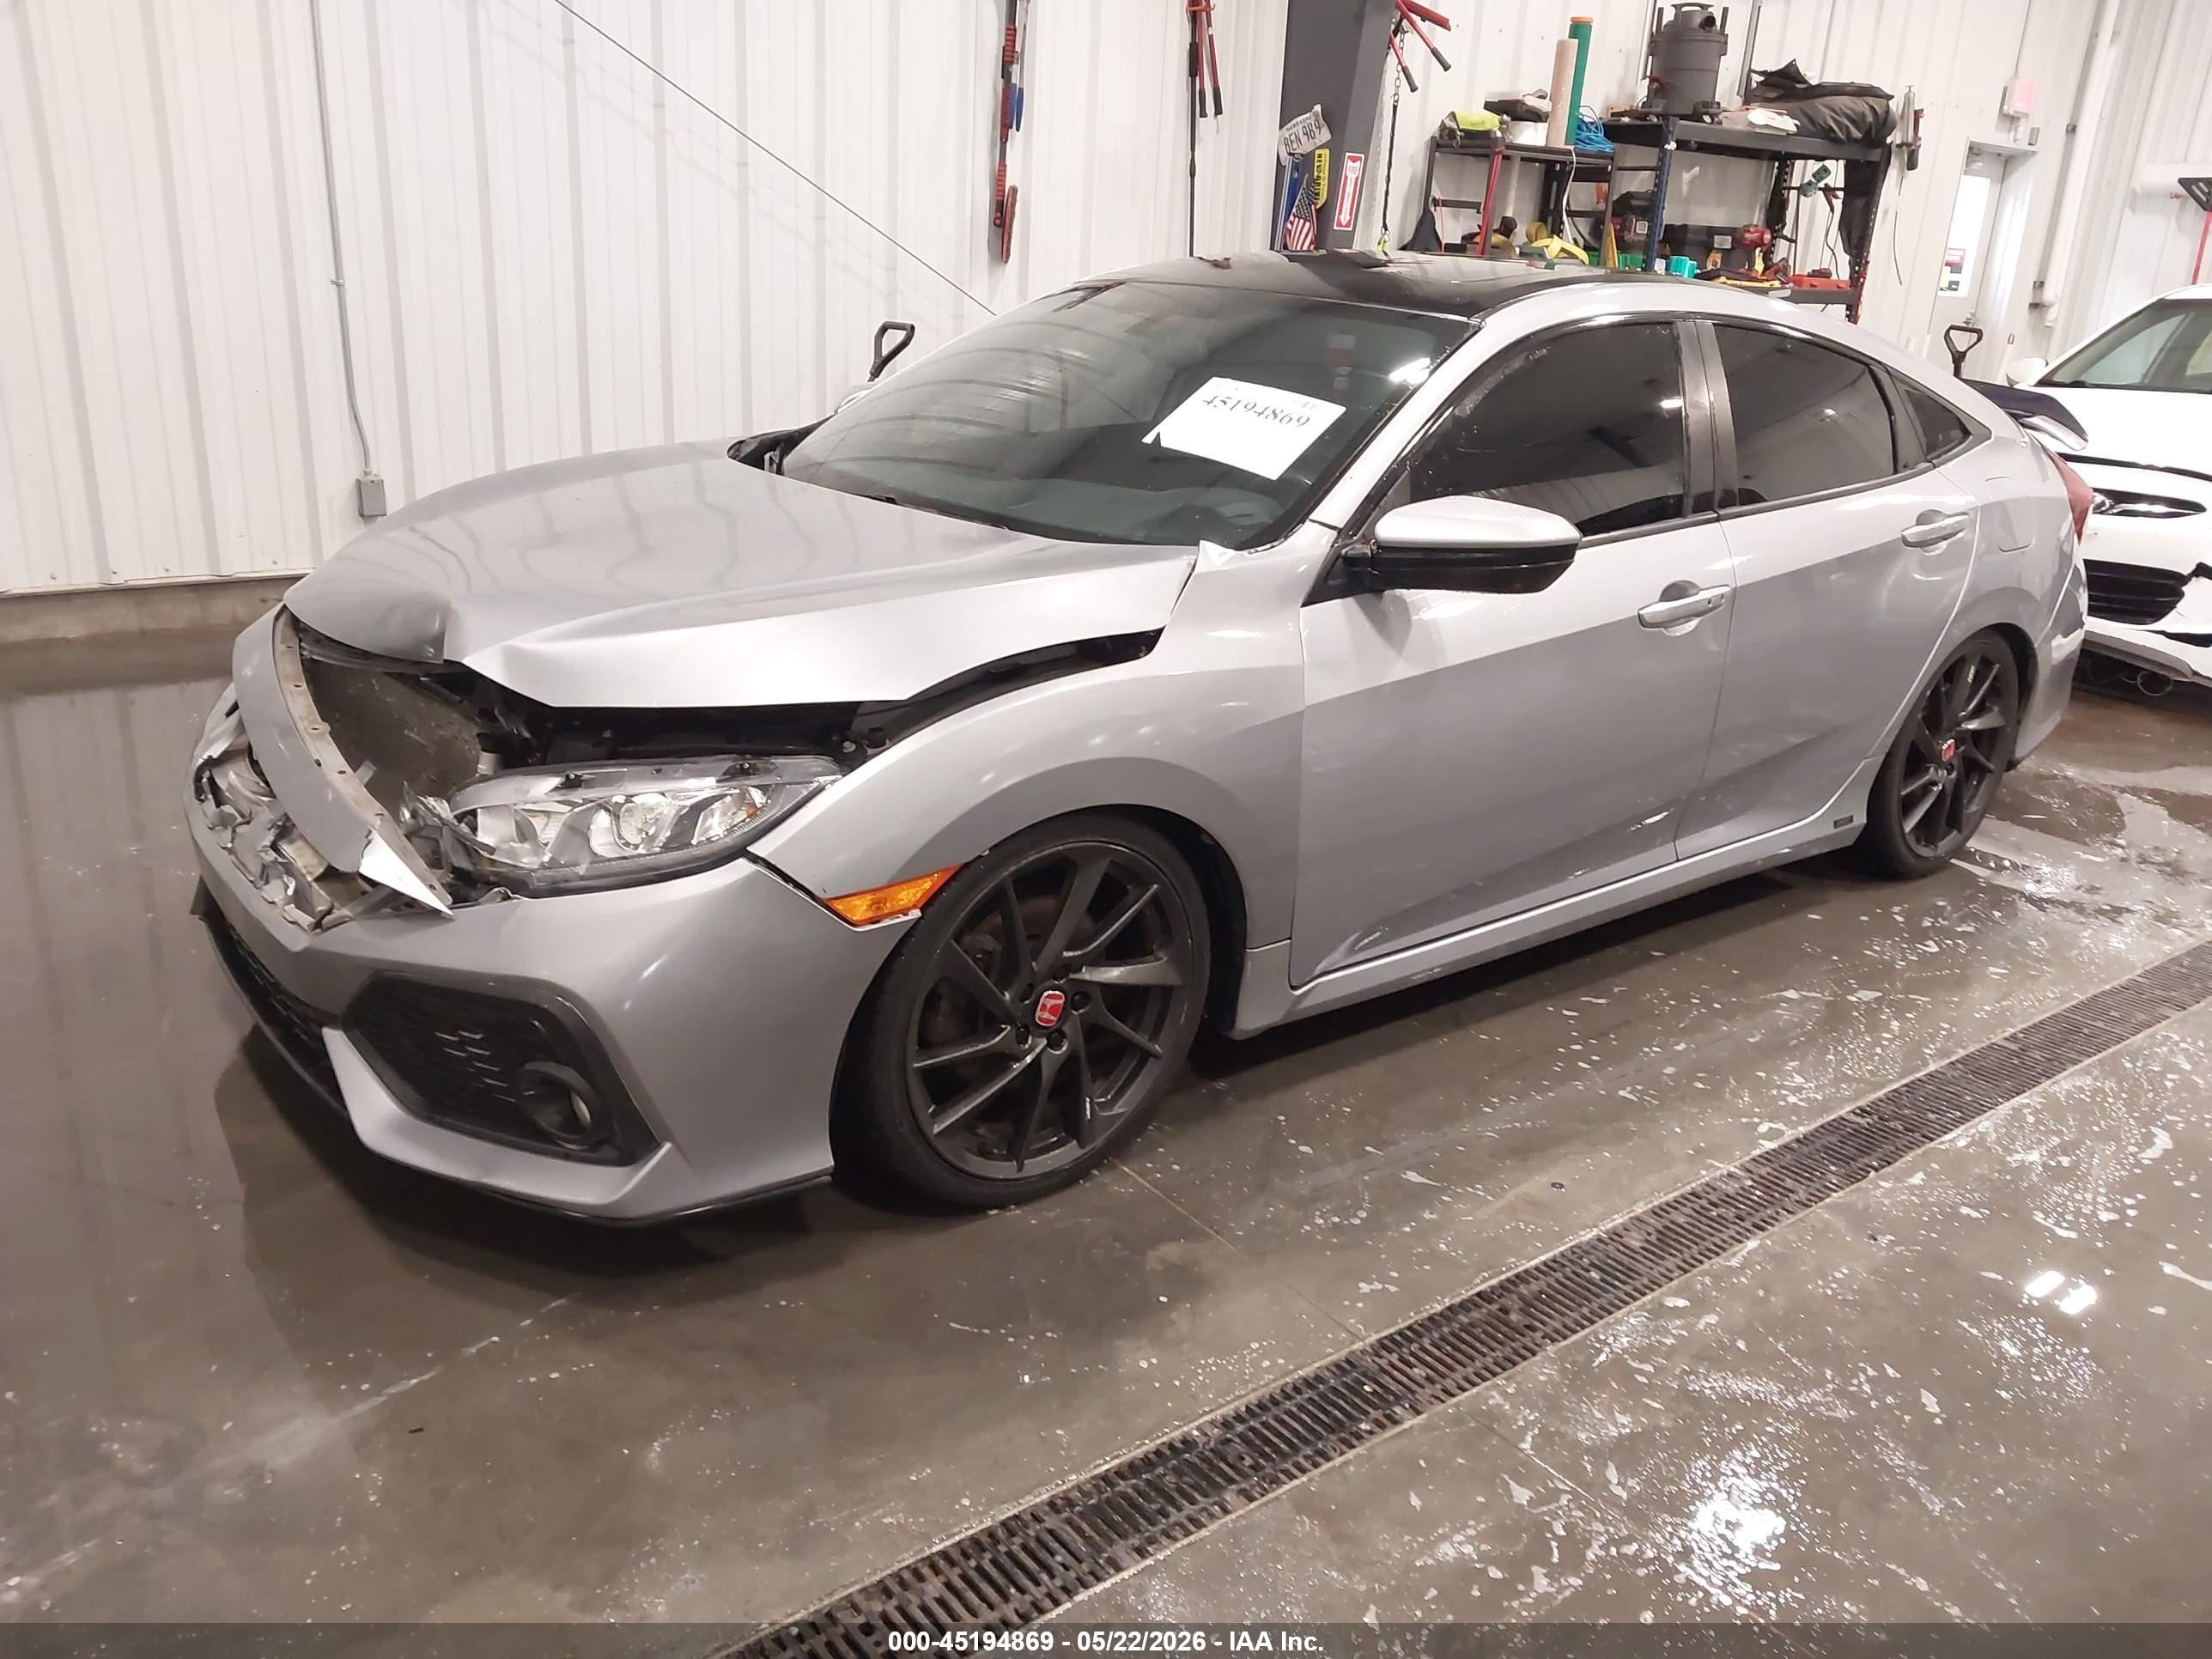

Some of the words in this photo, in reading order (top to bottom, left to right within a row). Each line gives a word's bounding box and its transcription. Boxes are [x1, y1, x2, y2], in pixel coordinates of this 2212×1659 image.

[1283, 129, 1303, 155] BEN
[1302, 118, 1322, 143] 989
[1202, 395, 1310, 427] 45194869
